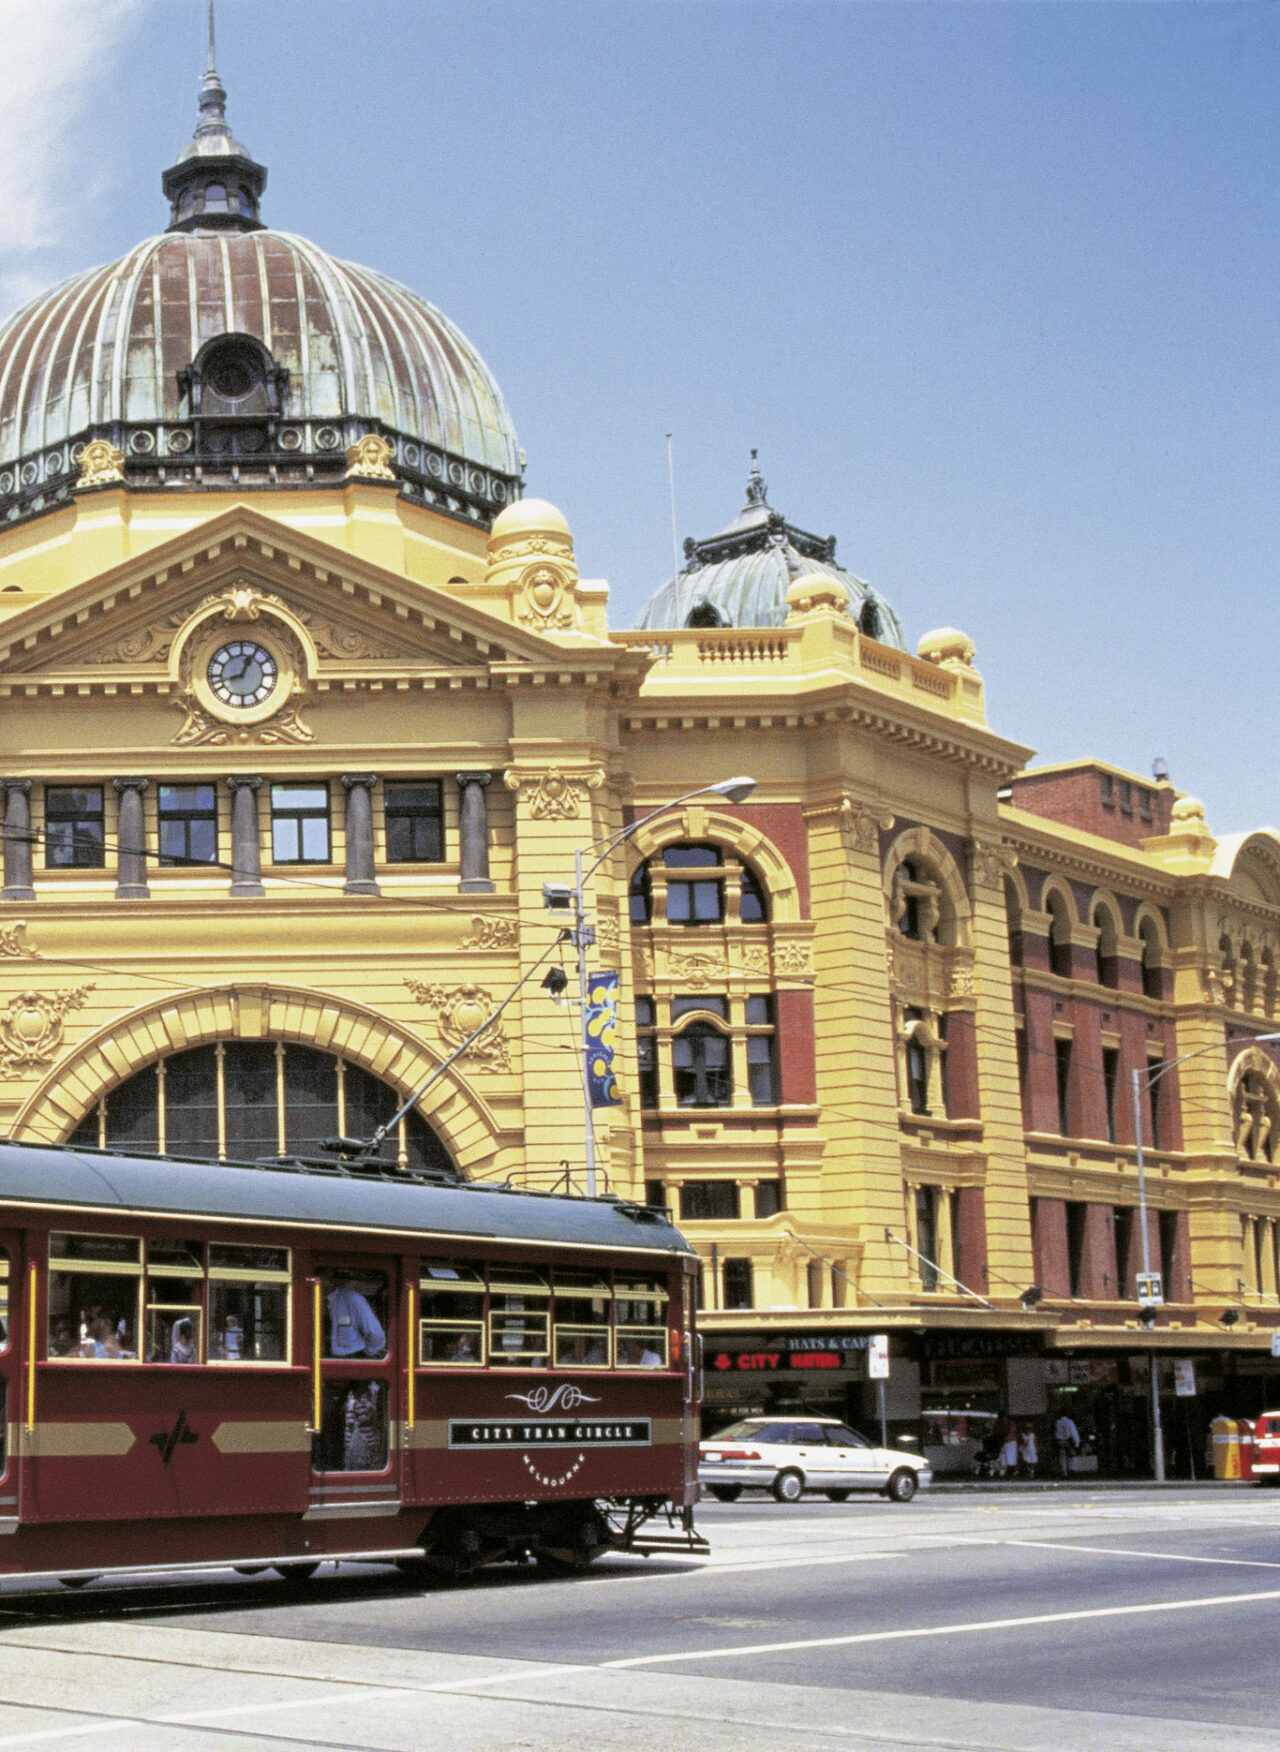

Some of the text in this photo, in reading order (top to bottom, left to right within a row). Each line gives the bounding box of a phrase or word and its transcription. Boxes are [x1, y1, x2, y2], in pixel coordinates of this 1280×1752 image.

[789, 1336, 870, 1349] HATS & CAP
[737, 1353, 841, 1369] CITY HATTERS
[472, 1426, 632, 1439] CITY TRAM CIRCLE
[523, 1453, 585, 1487] MELBOURNE
